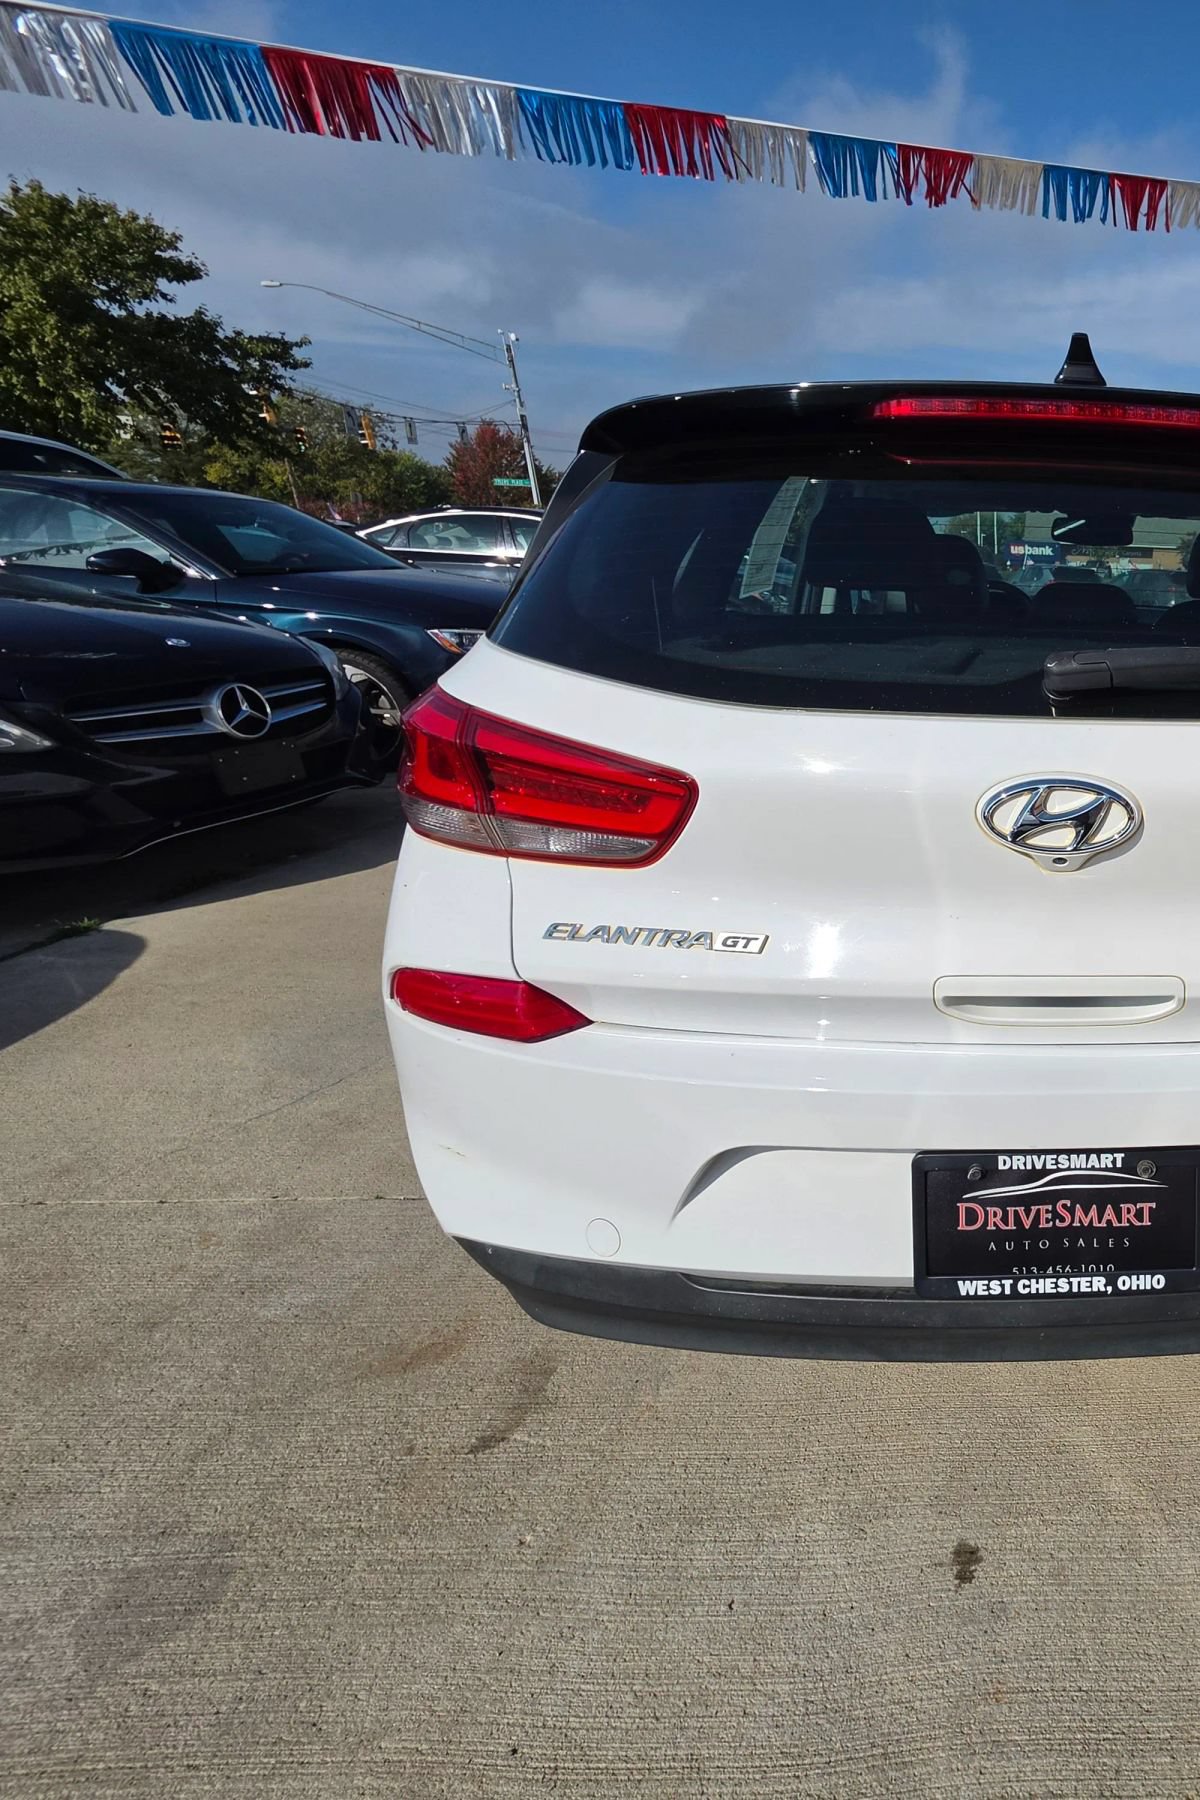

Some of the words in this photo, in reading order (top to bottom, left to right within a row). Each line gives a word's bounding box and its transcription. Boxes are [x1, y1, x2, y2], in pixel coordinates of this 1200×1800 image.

[542, 922, 714, 950] ELANTRA
[721, 935, 760, 949] GT
[998, 1153, 1125, 1170] DRIVESMART
[989, 1239, 1049, 1251] AUTO
[1063, 1237, 1130, 1248] SALES
[957, 1279, 1012, 1296] WEST
[1016, 1276, 1111, 1296] CHESTER,
[1117, 1274, 1166, 1291] OHIO
